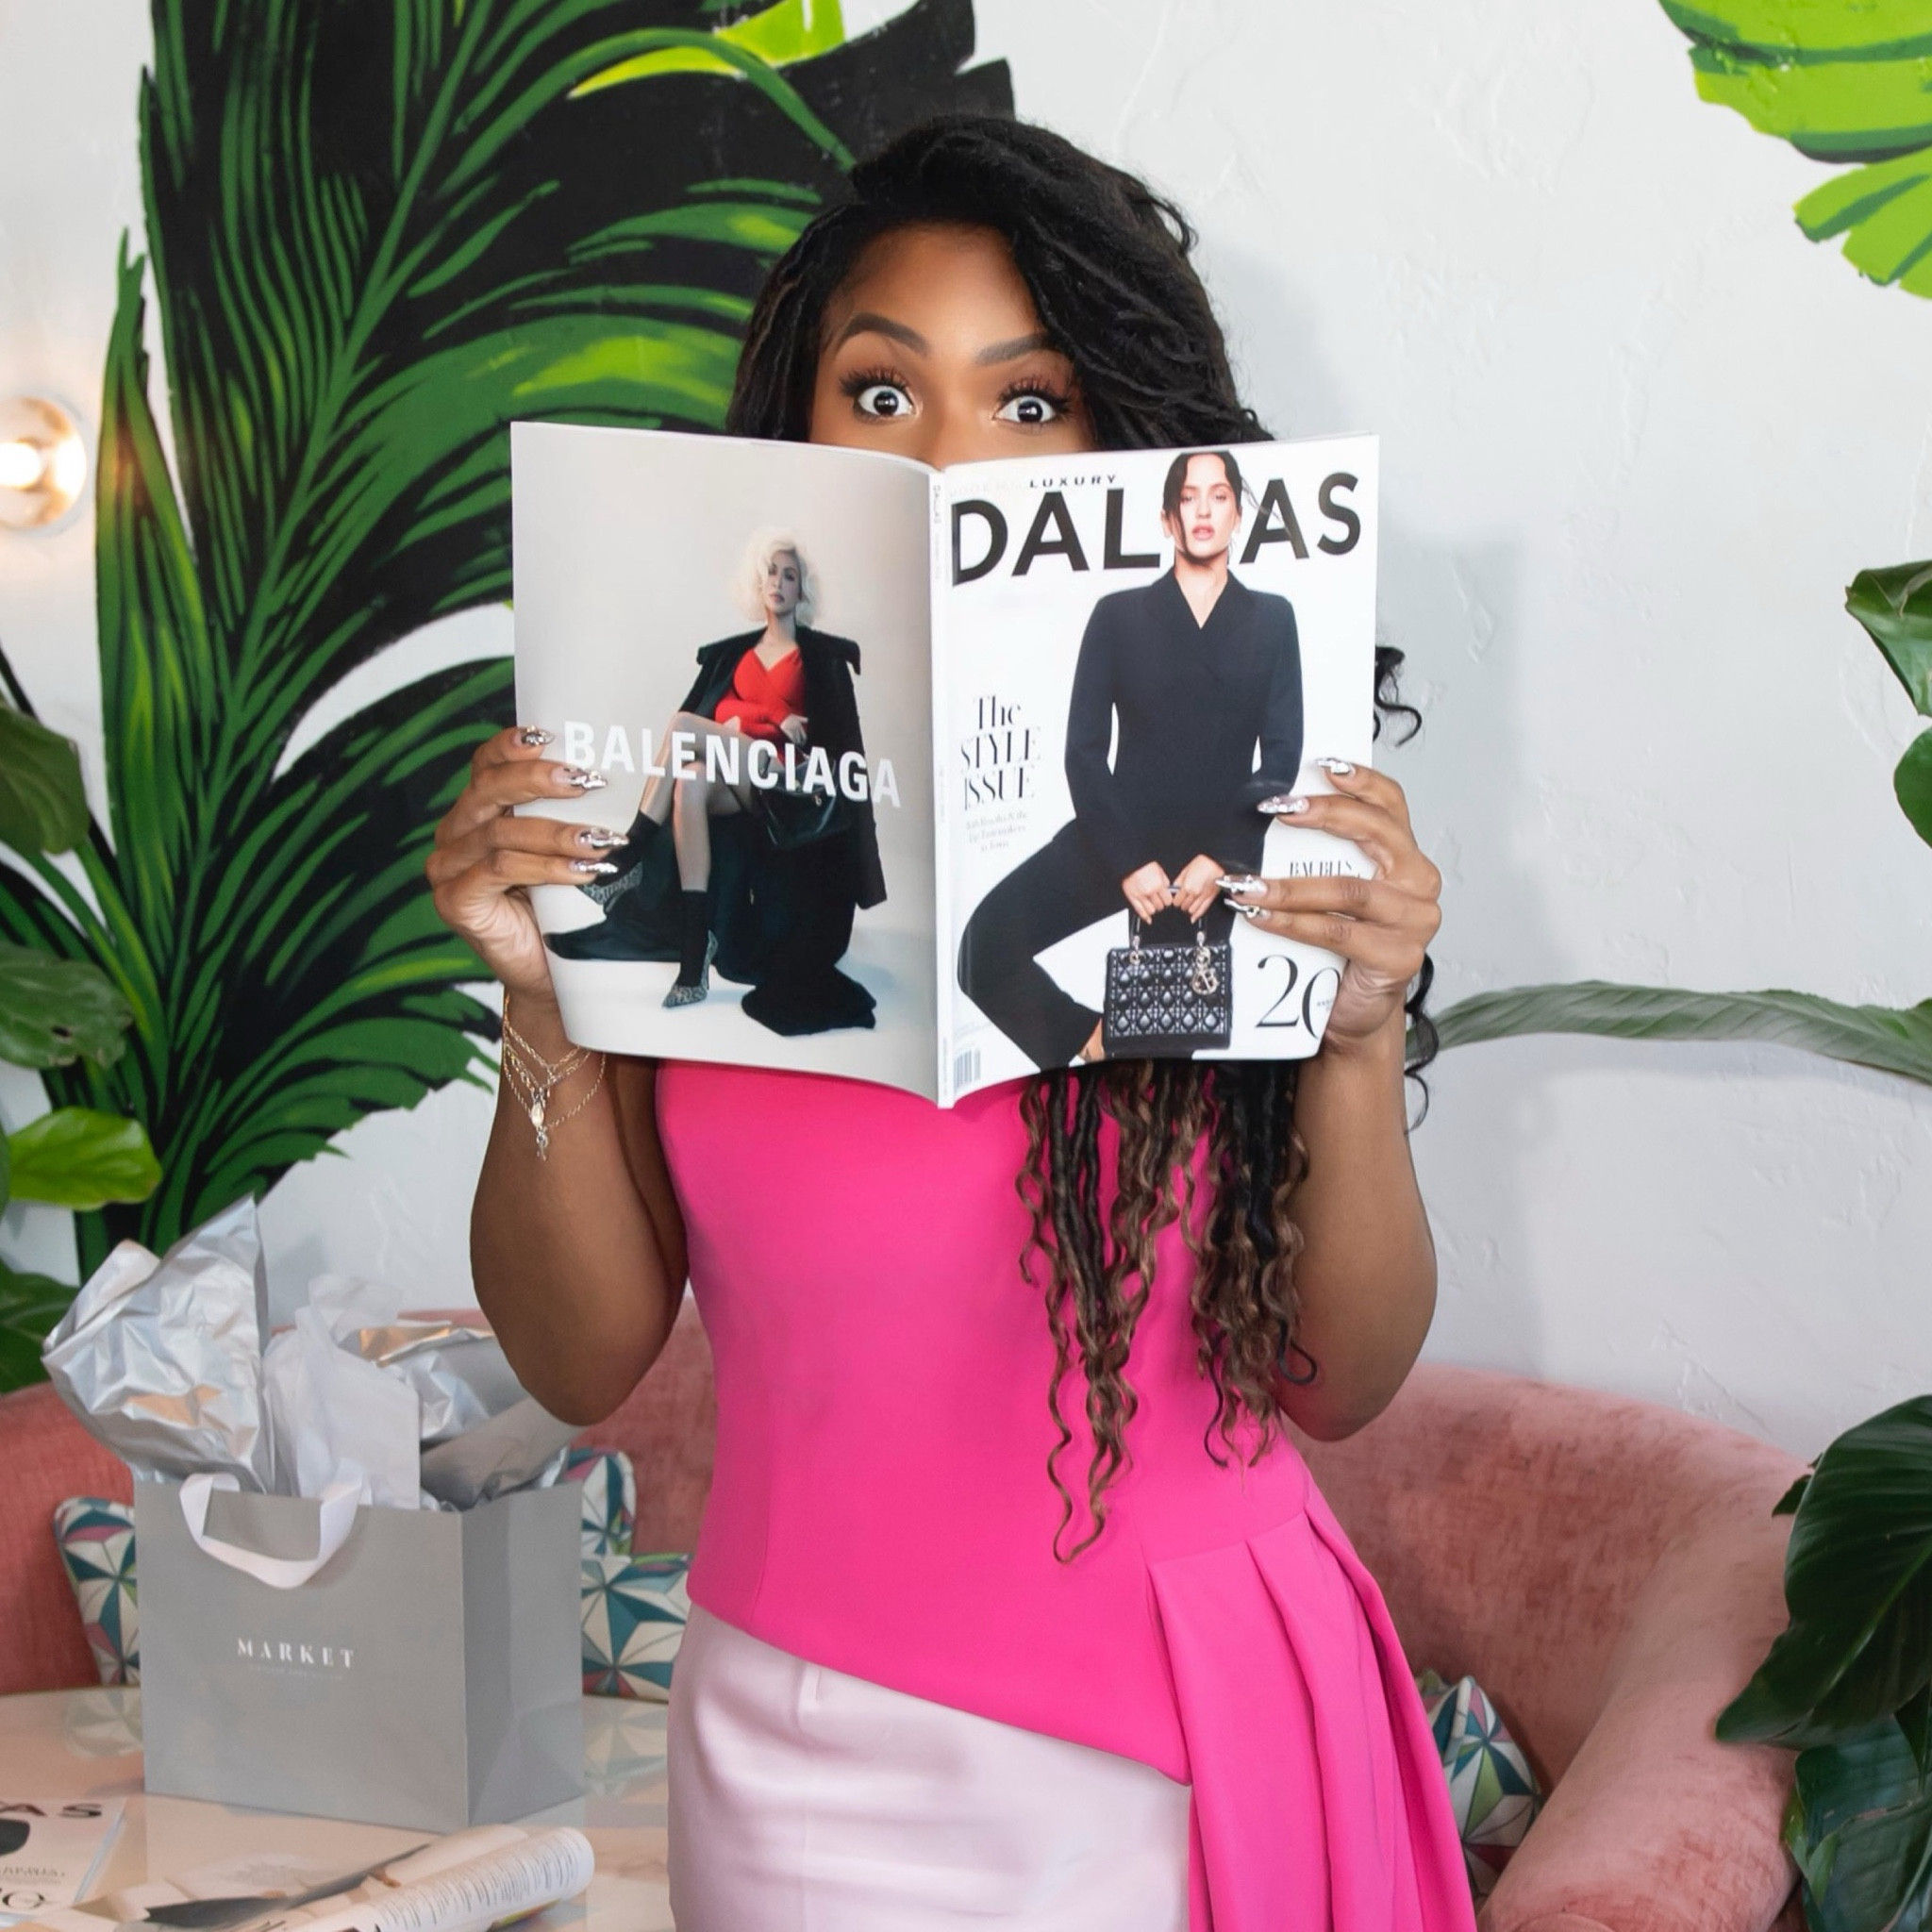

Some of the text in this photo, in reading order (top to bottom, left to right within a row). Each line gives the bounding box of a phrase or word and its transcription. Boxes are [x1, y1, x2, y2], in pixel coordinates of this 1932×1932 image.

[1029, 474, 1117, 489] LUXURY
[952, 472, 1361, 587] DALAS
[973, 694, 1022, 730] The
[564, 721, 901, 808] BALENCIAGA
[960, 725, 1041, 770] STYLE
[963, 763, 1036, 811] ISSUE
[238, 1637, 354, 1669] MARKET
